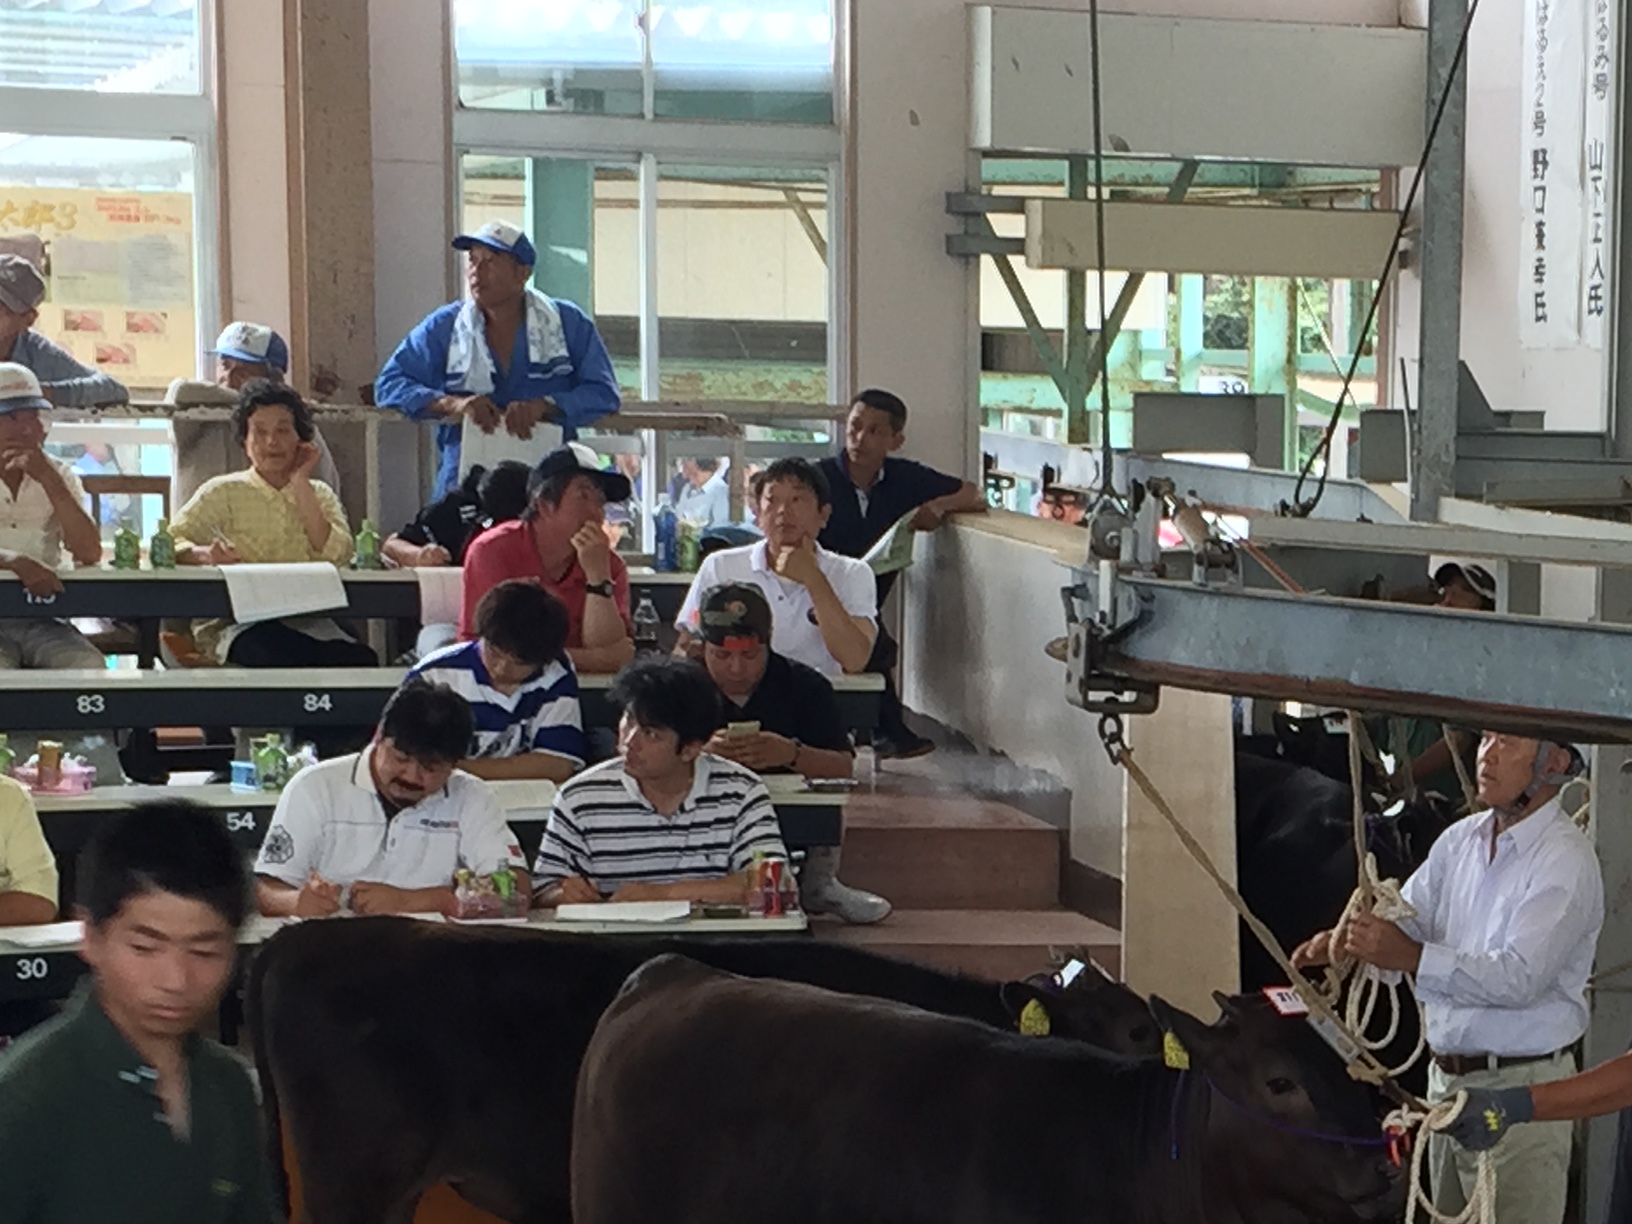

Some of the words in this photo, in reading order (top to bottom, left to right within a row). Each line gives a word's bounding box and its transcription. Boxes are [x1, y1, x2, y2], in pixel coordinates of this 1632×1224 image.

[76, 695, 105, 713] 83
[303, 693, 333, 711] 84
[226, 811, 256, 831] 54
[16, 957, 48, 979] 30
